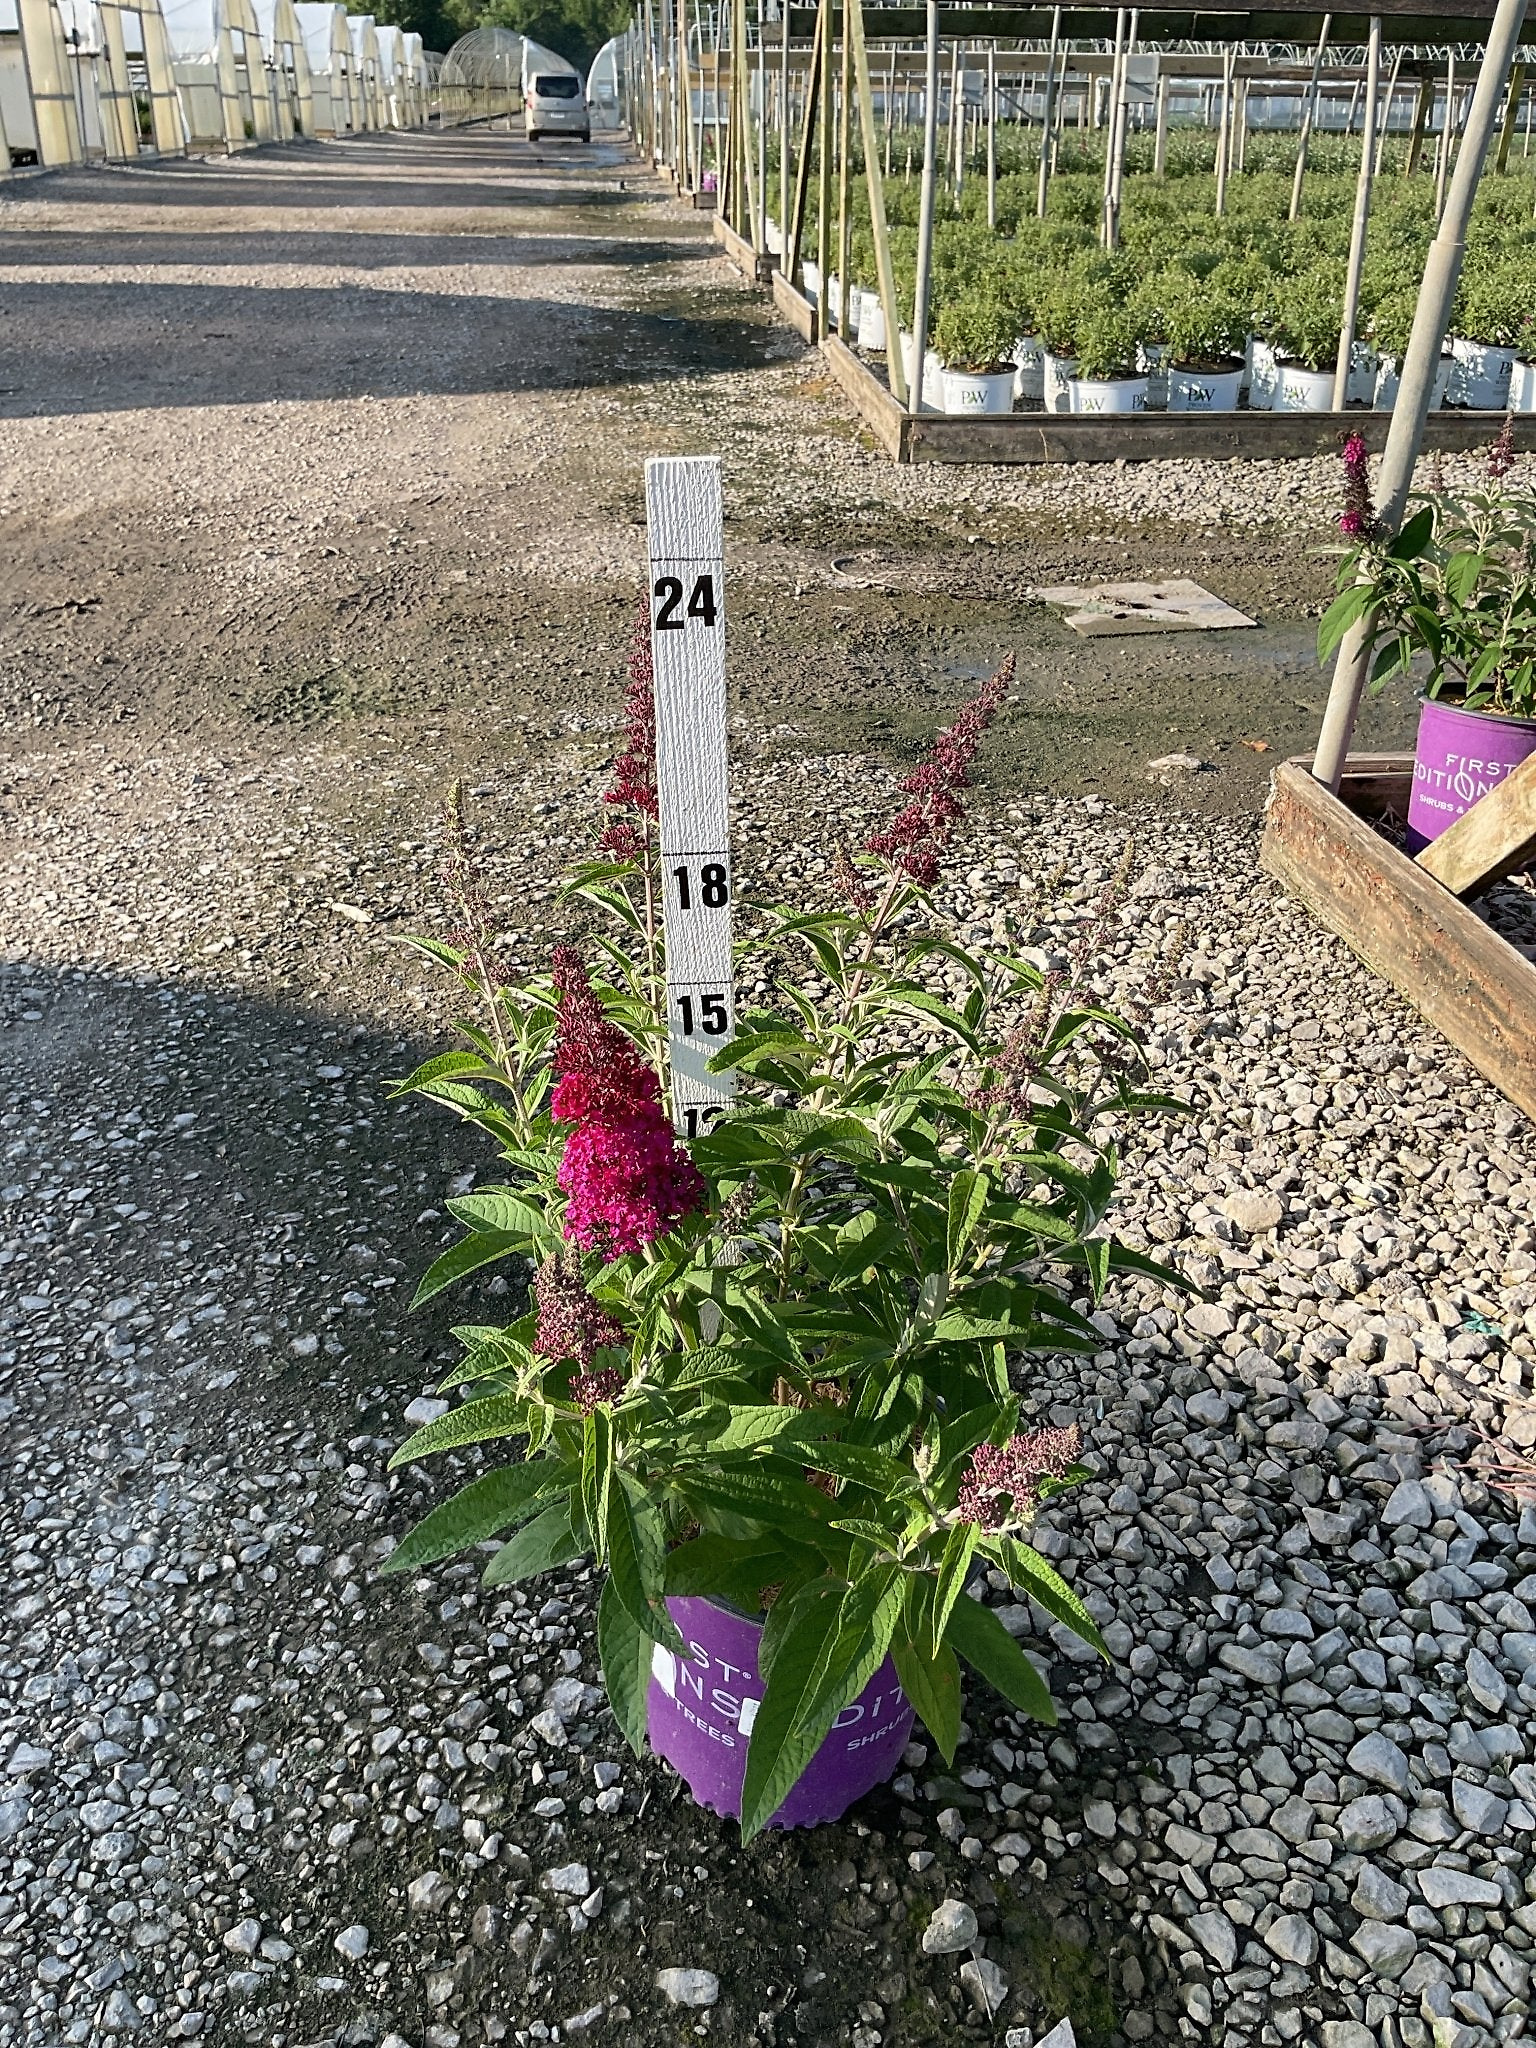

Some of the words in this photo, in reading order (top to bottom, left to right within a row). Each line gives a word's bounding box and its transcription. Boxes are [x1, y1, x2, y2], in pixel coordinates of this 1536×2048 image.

[961, 391, 988, 405] PW
[1081, 398, 1104, 411] PW
[1188, 388, 1216, 402] PW
[654, 574, 718, 631] 24
[1445, 753, 1518, 777] FIRST
[1419, 793, 1454, 812] SHRUBS
[1456, 806, 1464, 814] &
[673, 863, 729, 910] 18
[677, 993, 729, 1036] 15
[674, 1697, 735, 1747] TREES
